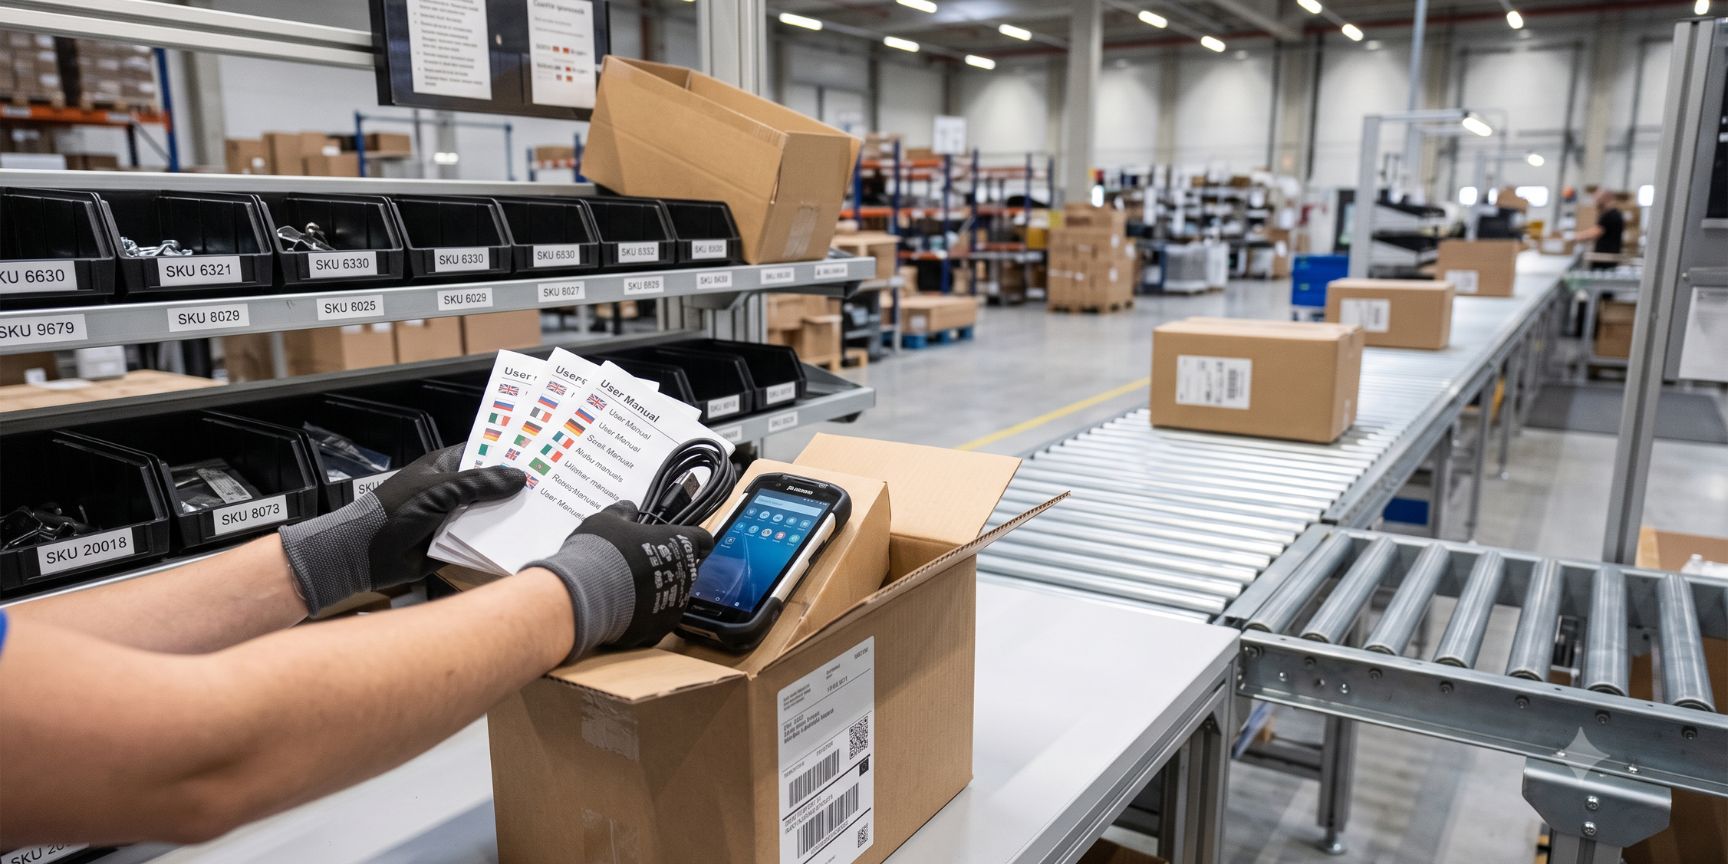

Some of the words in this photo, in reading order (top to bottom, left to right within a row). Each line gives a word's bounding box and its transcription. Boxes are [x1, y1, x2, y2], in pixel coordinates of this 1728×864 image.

[439, 254, 459, 265] SKU
[461, 253, 484, 264] 6330
[537, 251, 554, 260] SKU
[621, 248, 636, 257] SKU
[166, 265, 195, 278] SKU
[200, 263, 231, 276] 6321
[315, 259, 340, 271] SKU
[343, 257, 370, 269] 6330
[0, 270, 19, 284] KU
[24, 269, 65, 283] 6630
[543, 288, 560, 297] SKU
[627, 281, 643, 290] SKU
[443, 294, 463, 305] SKU
[465, 293, 487, 303] 6029
[324, 302, 348, 314] SKU
[178, 312, 206, 325] SKU
[210, 310, 240, 323] 8029
[0, 324, 31, 339] SKU
[37, 322, 75, 336] 9679
[504, 366, 532, 380] User
[555, 365, 583, 382] User
[600, 379, 625, 398] User
[624, 395, 660, 423] Manual
[609, 408, 626, 423] User
[625, 420, 652, 440] Manual
[598, 422, 616, 436] User
[615, 433, 641, 453] Manual
[221, 511, 248, 526] SKU
[251, 503, 280, 519] 8073
[46, 546, 78, 564] SKU
[83, 536, 127, 556] 20018
[11, 848, 42, 864] SKU
